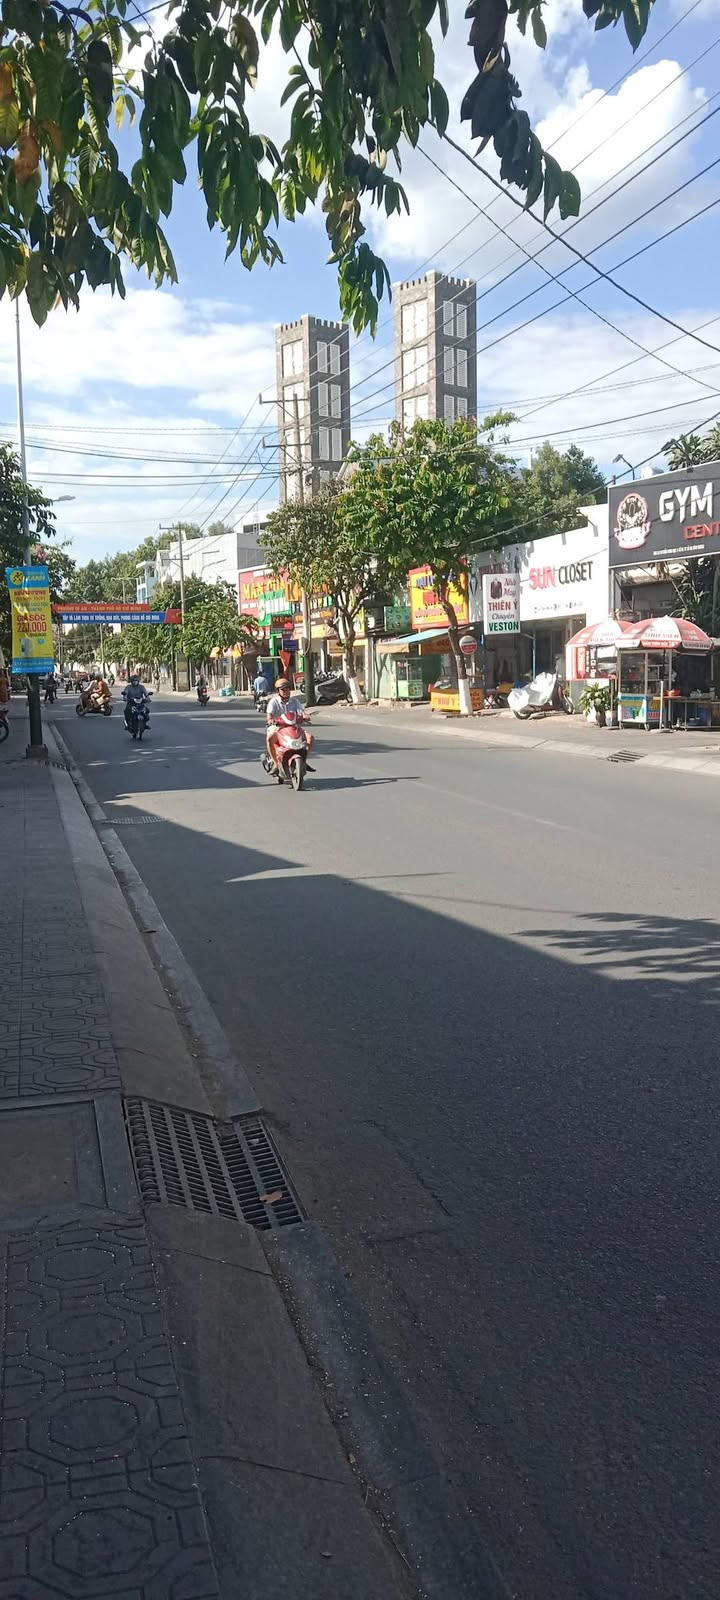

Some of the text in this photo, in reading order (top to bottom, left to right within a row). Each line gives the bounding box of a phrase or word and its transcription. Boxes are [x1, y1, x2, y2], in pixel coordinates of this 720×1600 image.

[659, 481, 713, 524] GYM
[529, 566, 556, 590] SUN
[559, 561, 593, 585] CLOSET
[488, 600, 510, 611] THIÊN
[489, 621, 518, 631] VESTON
